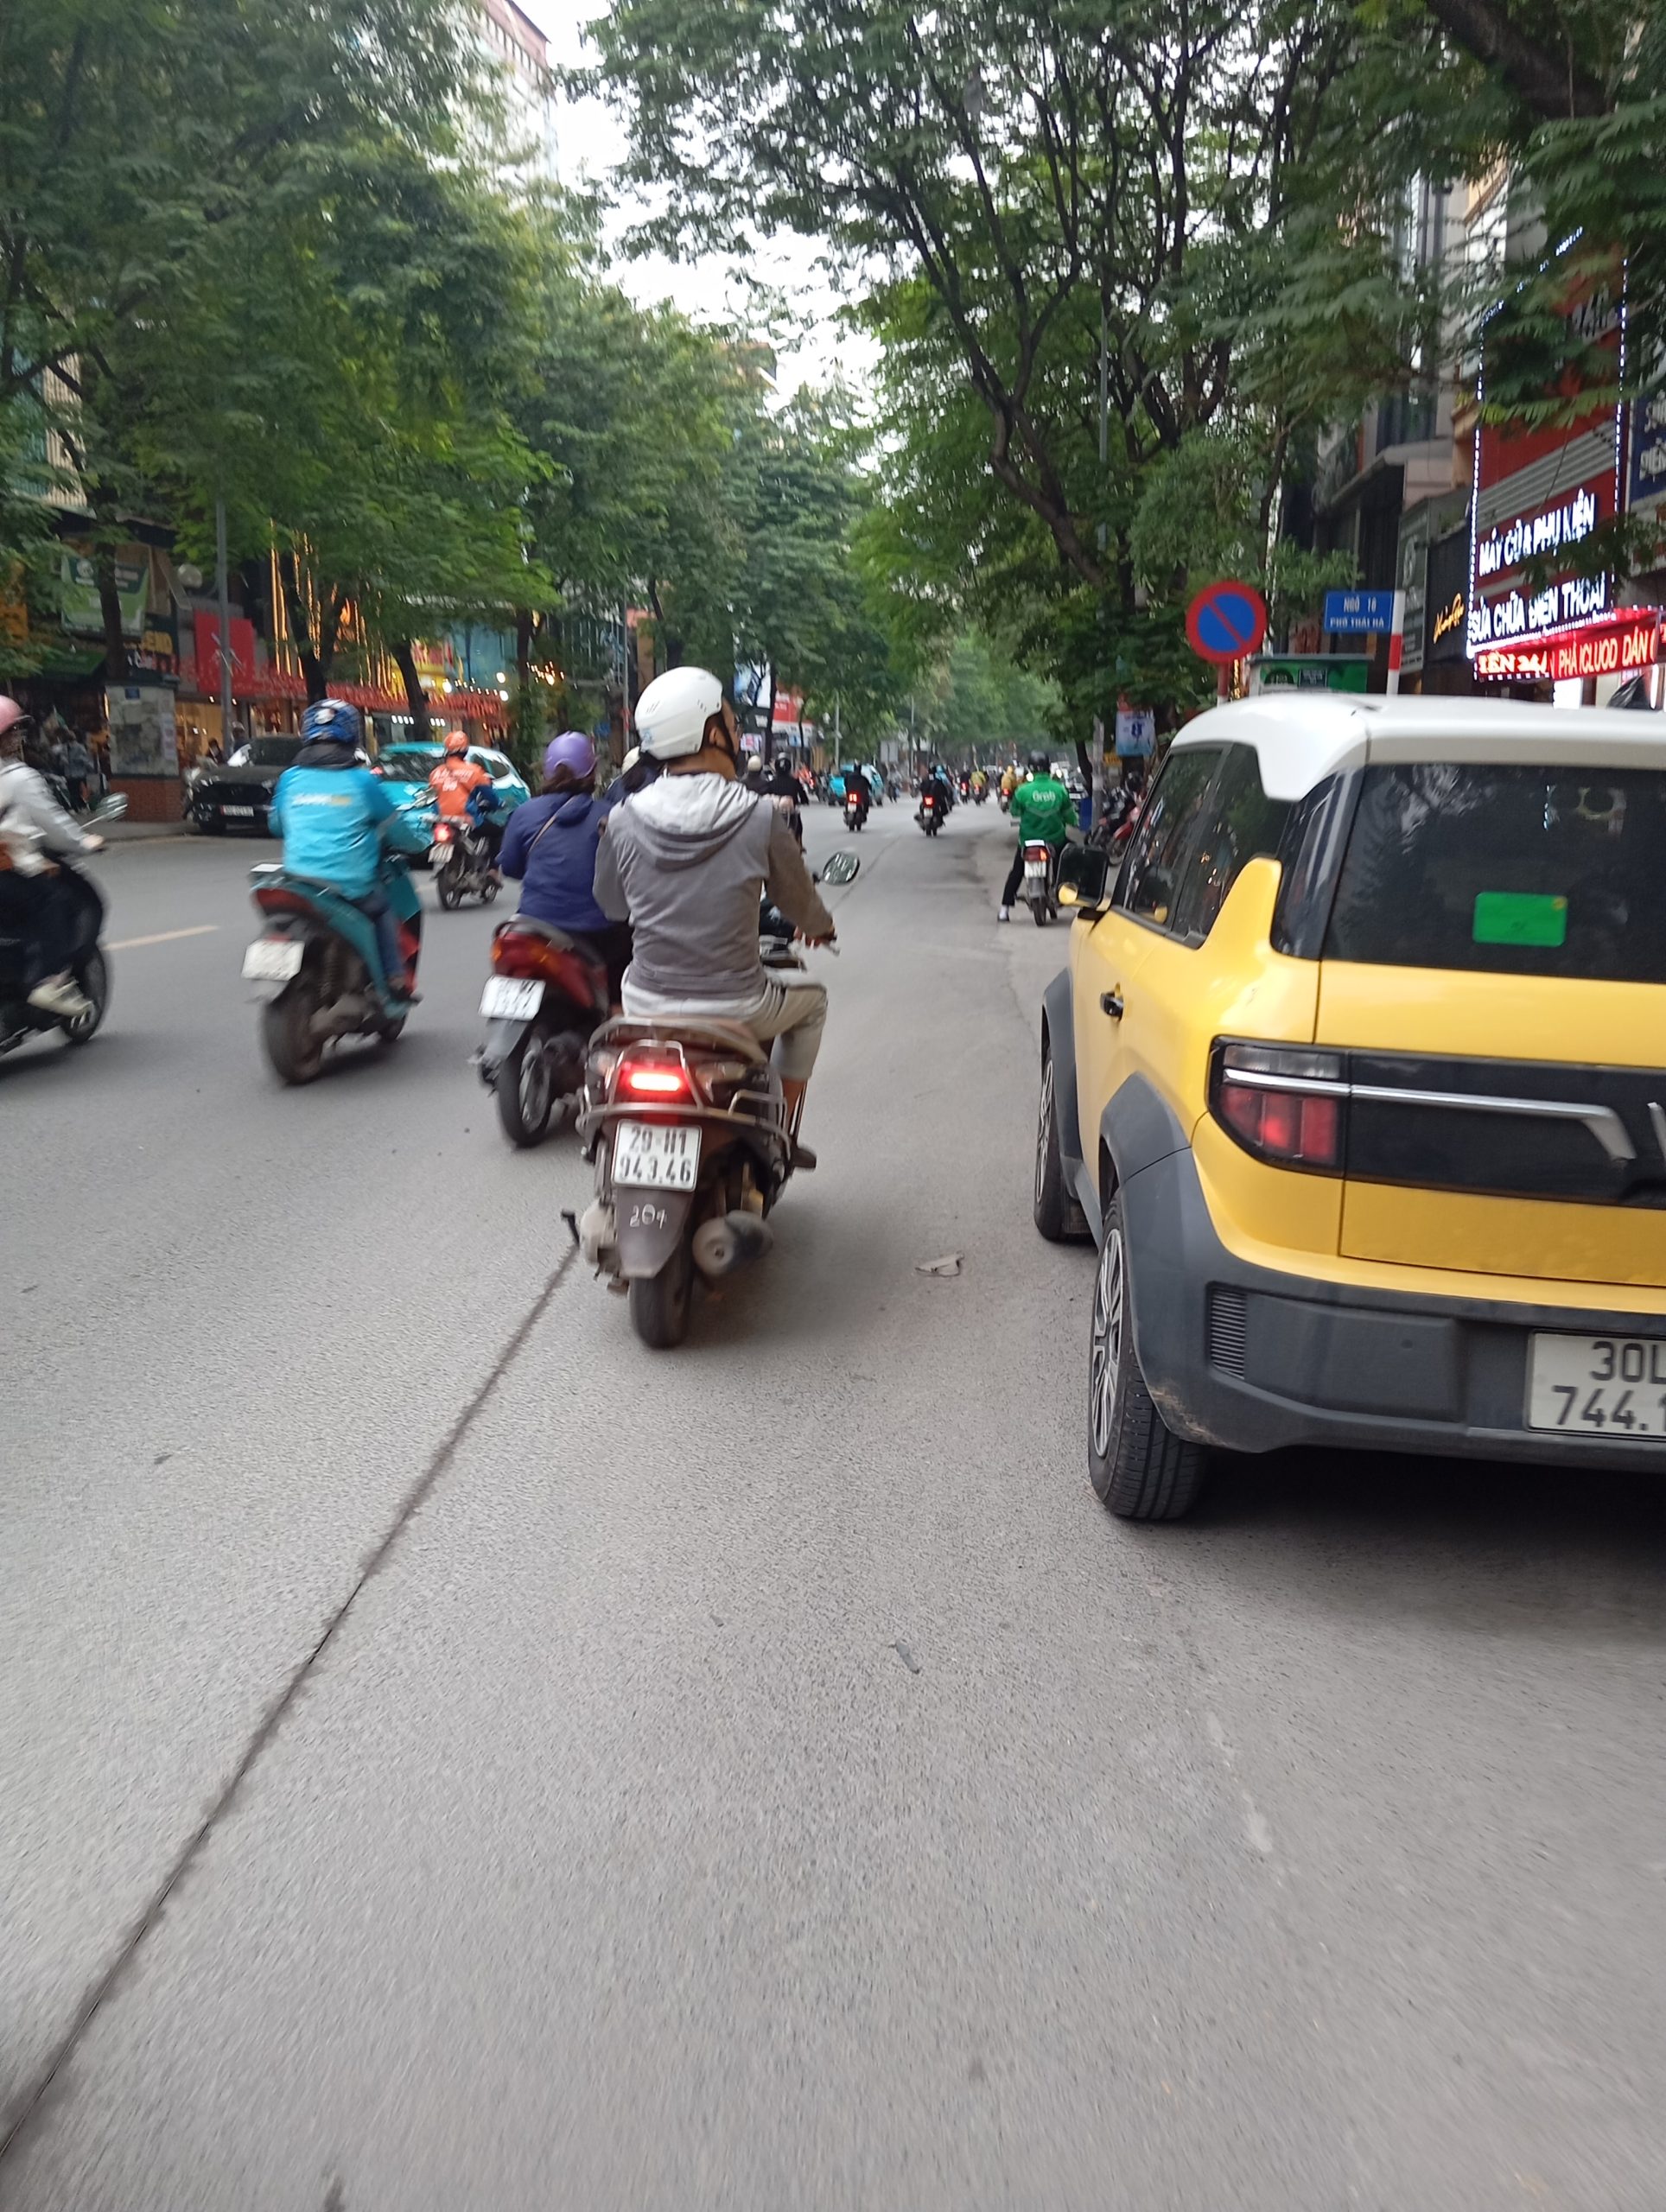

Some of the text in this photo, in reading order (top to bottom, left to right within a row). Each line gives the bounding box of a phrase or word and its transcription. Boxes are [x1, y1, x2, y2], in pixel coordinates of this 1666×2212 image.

[1533, 508, 1561, 556] PHỤ
[1622, 626, 1649, 666] DÁN
[1032, 789, 1056, 803] Grab
